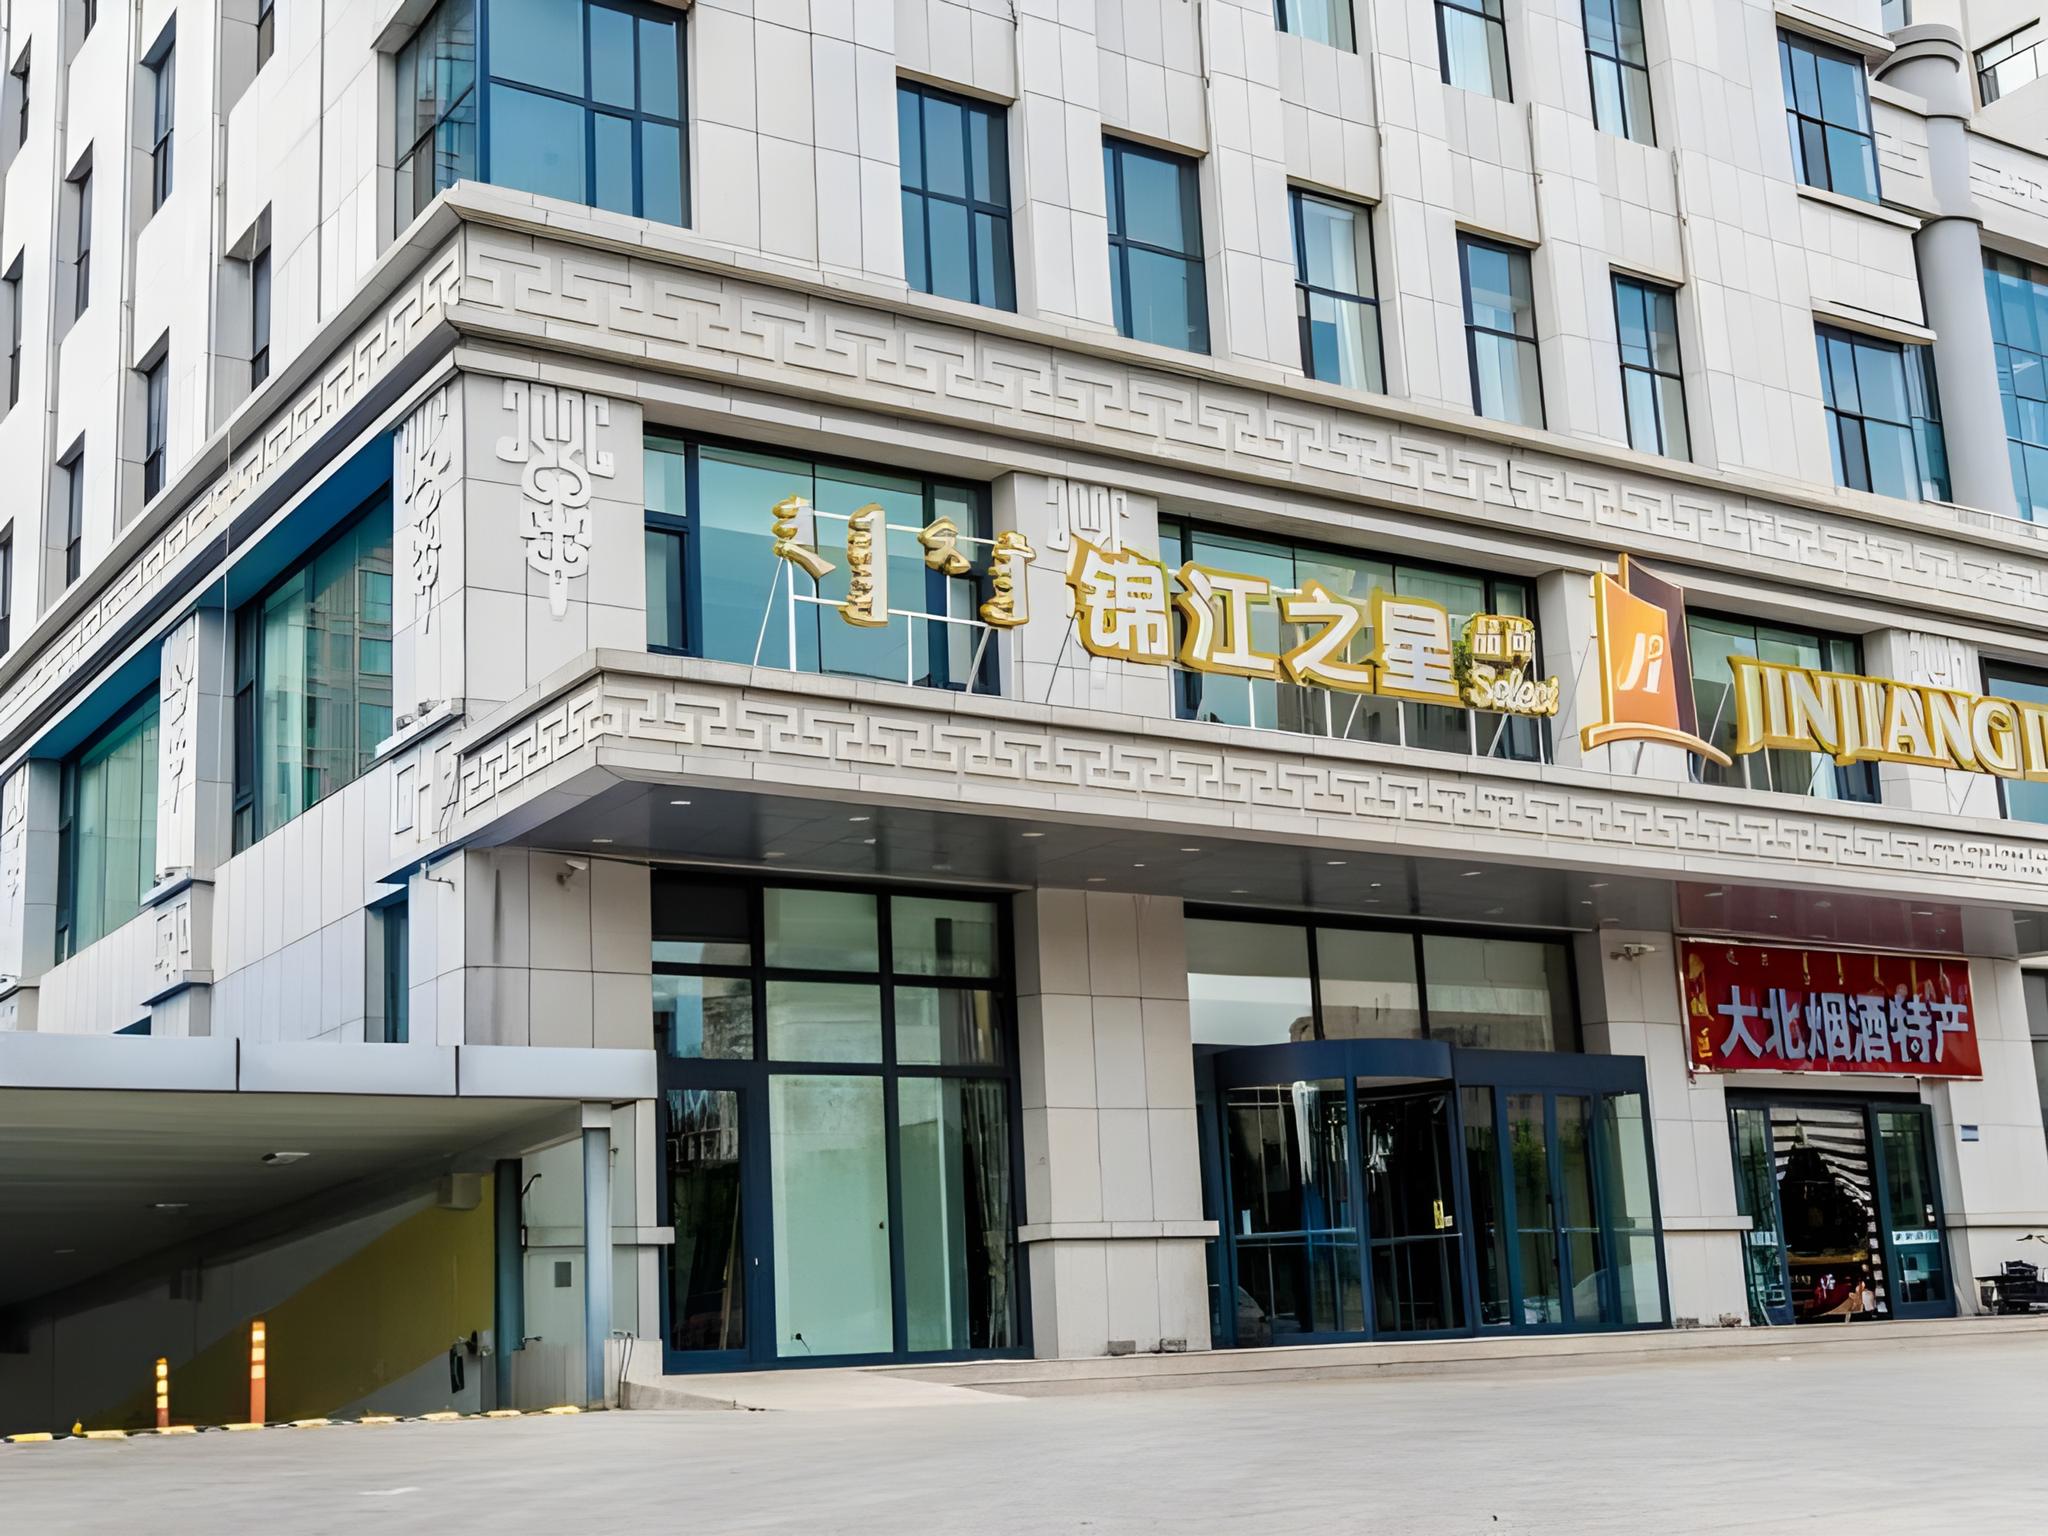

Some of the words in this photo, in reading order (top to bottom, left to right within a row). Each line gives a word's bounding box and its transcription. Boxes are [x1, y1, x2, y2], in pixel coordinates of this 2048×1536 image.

[1068, 538, 1459, 702] 锦江之星
[1717, 984, 1969, 1063] 大北烟酒特产
